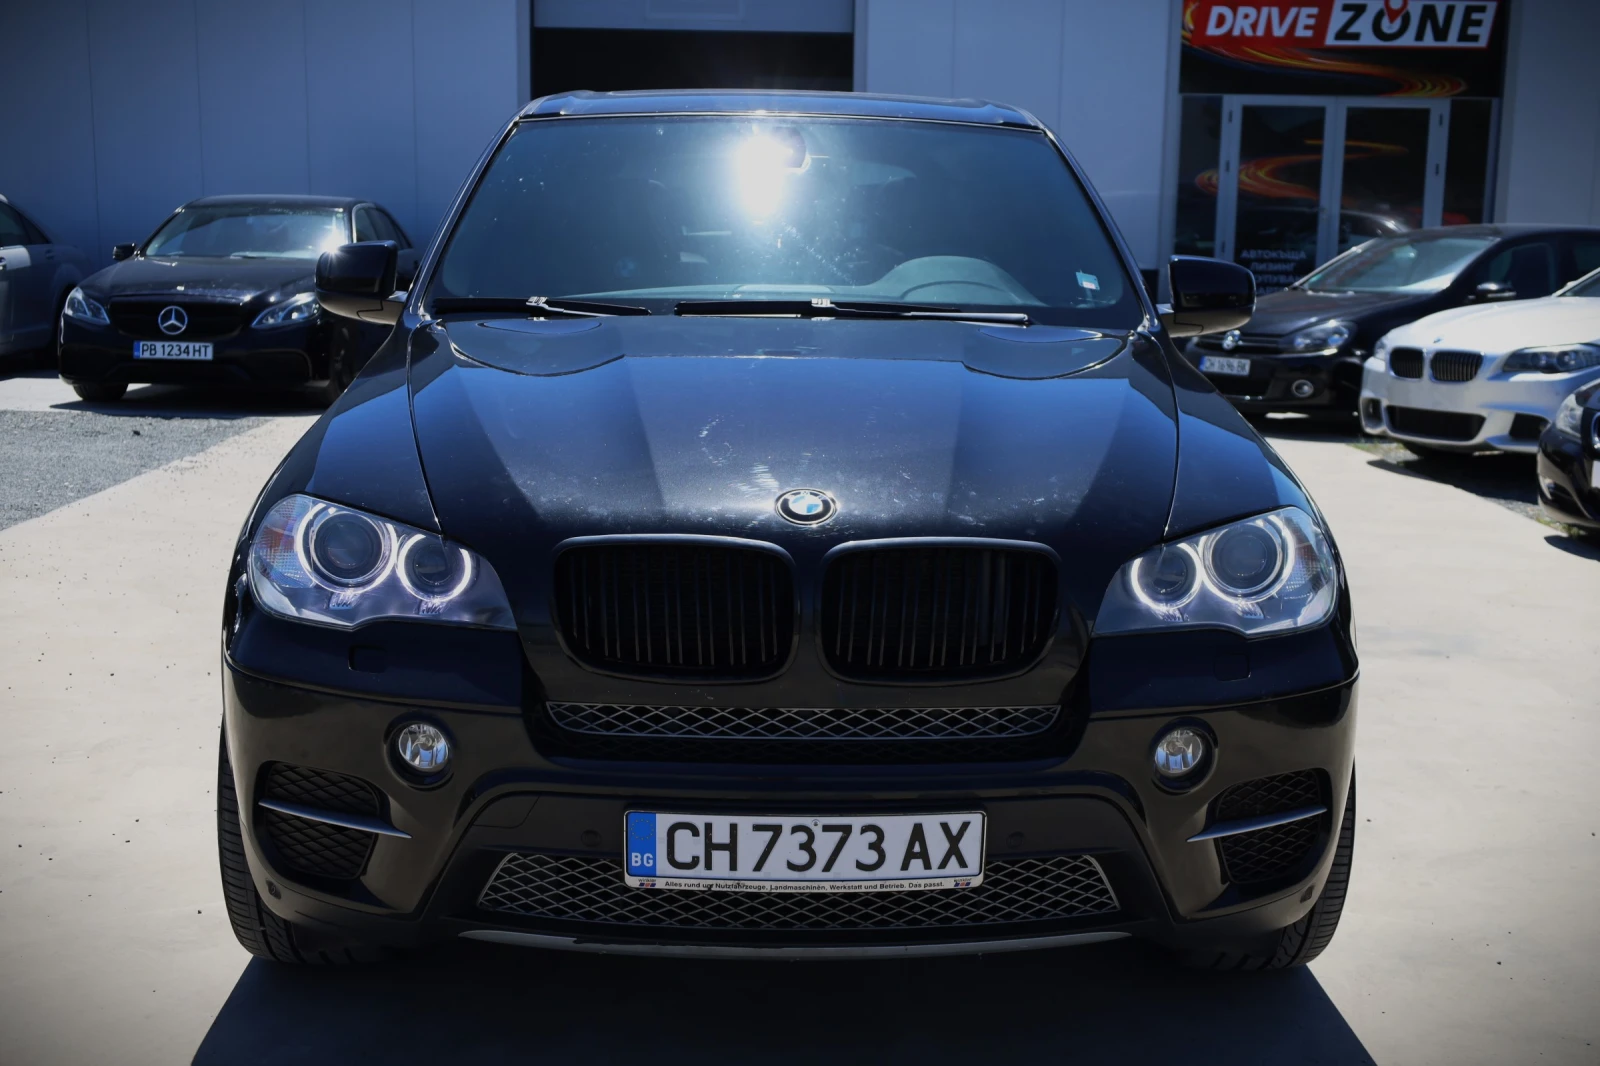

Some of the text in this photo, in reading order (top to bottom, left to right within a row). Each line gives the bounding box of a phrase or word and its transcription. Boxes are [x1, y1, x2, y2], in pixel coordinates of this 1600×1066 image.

[1206, 3, 1489, 43] DRIVE ZONE
[161, 344, 190, 357] 1234
[666, 820, 972, 873] CH 7373 AX
[631, 853, 654, 867] BG
[830, 883, 862, 891] Werkstatt
[924, 880, 945, 889] passt.
